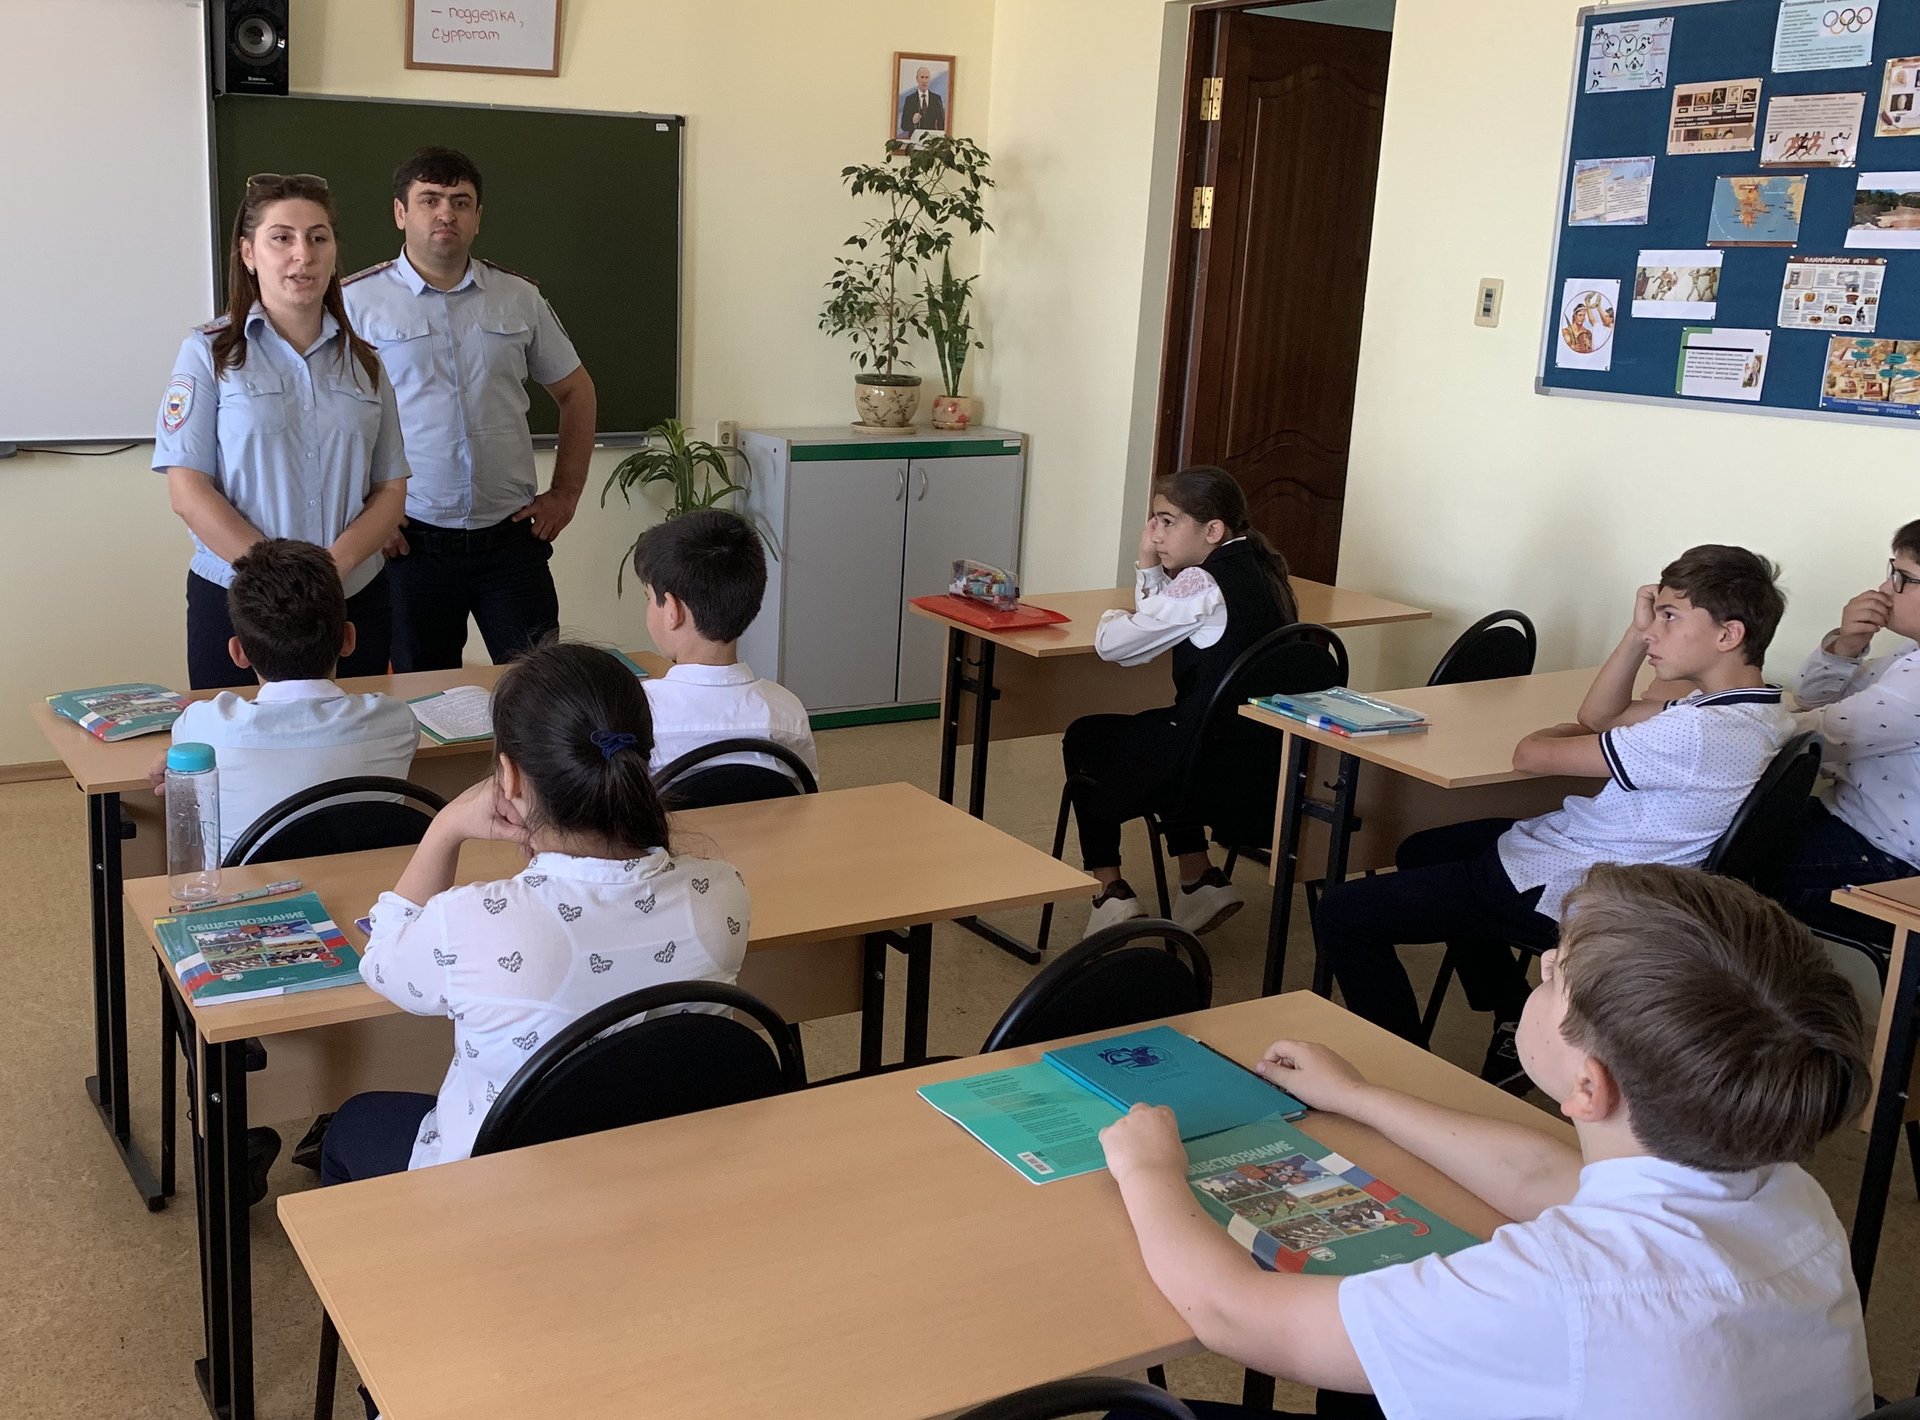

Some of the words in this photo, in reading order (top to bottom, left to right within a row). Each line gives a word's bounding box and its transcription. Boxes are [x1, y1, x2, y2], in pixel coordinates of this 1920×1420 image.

[187, 910, 306, 932] ОБЩЕСТВОЗНАНИЕ
[318, 951, 343, 968] 5
[1188, 1140, 1295, 1176] ЩЕСТВОЗНАНИЕ
[1383, 1207, 1431, 1237] 5
